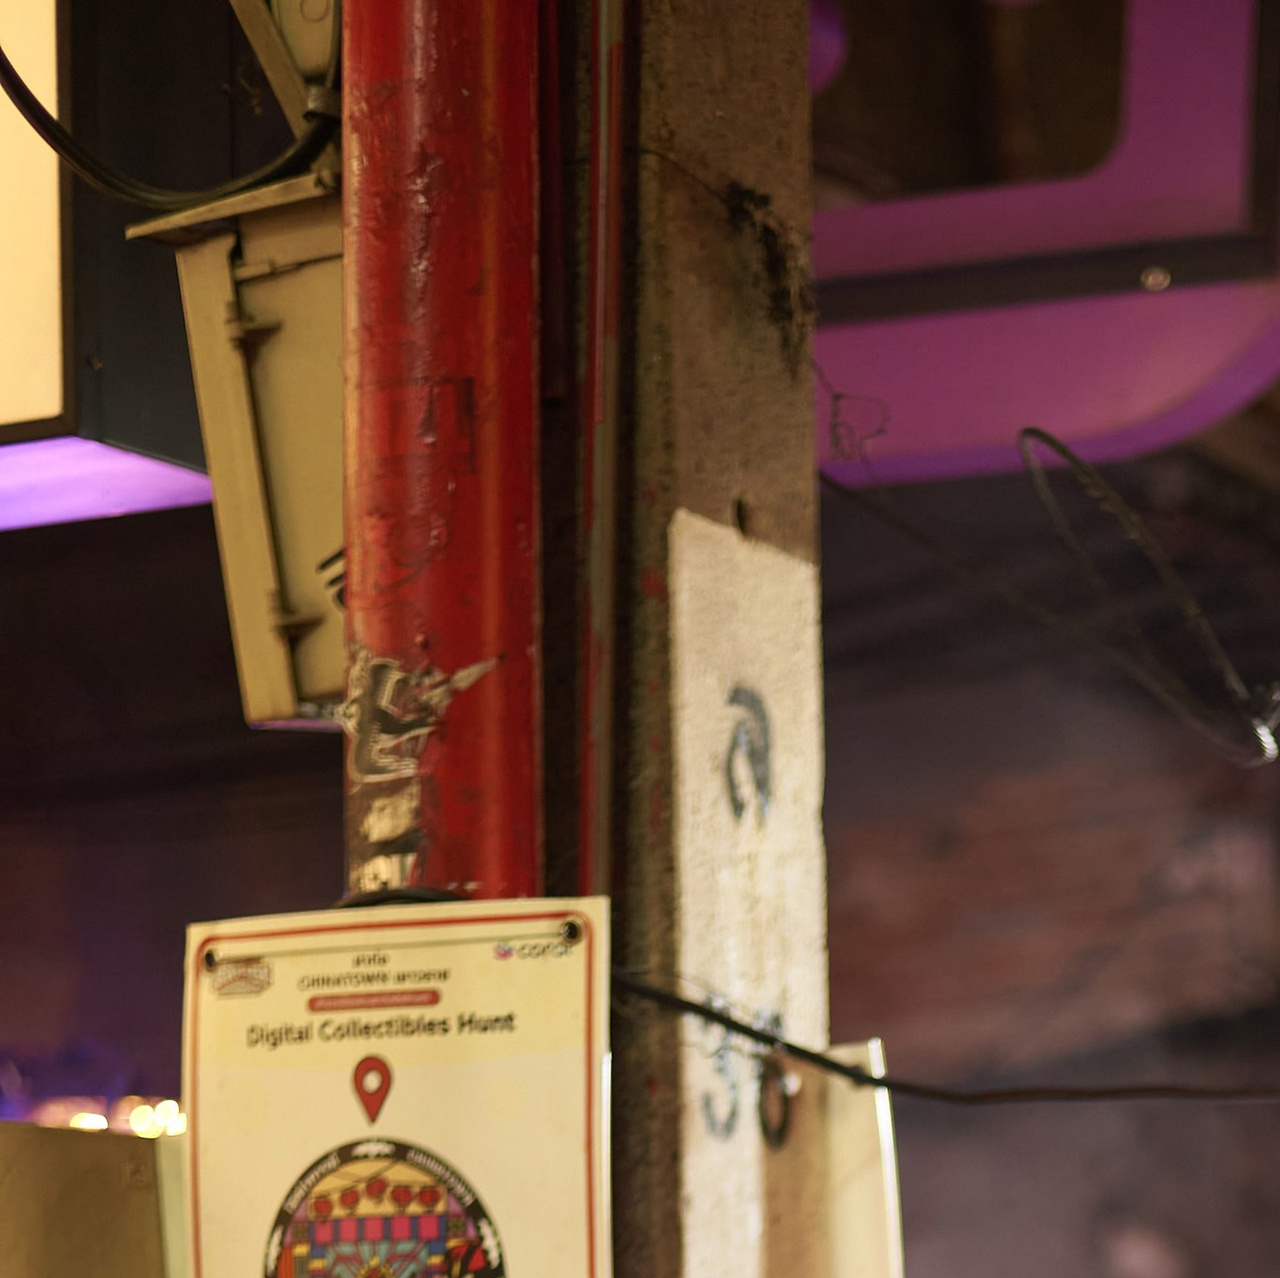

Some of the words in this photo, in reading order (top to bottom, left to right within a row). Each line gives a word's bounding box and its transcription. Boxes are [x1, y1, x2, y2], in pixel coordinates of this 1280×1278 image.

[247, 1022, 312, 1049] Digital
[318, 1015, 450, 1042] Collectibles
[458, 1012, 515, 1034] Hunt
